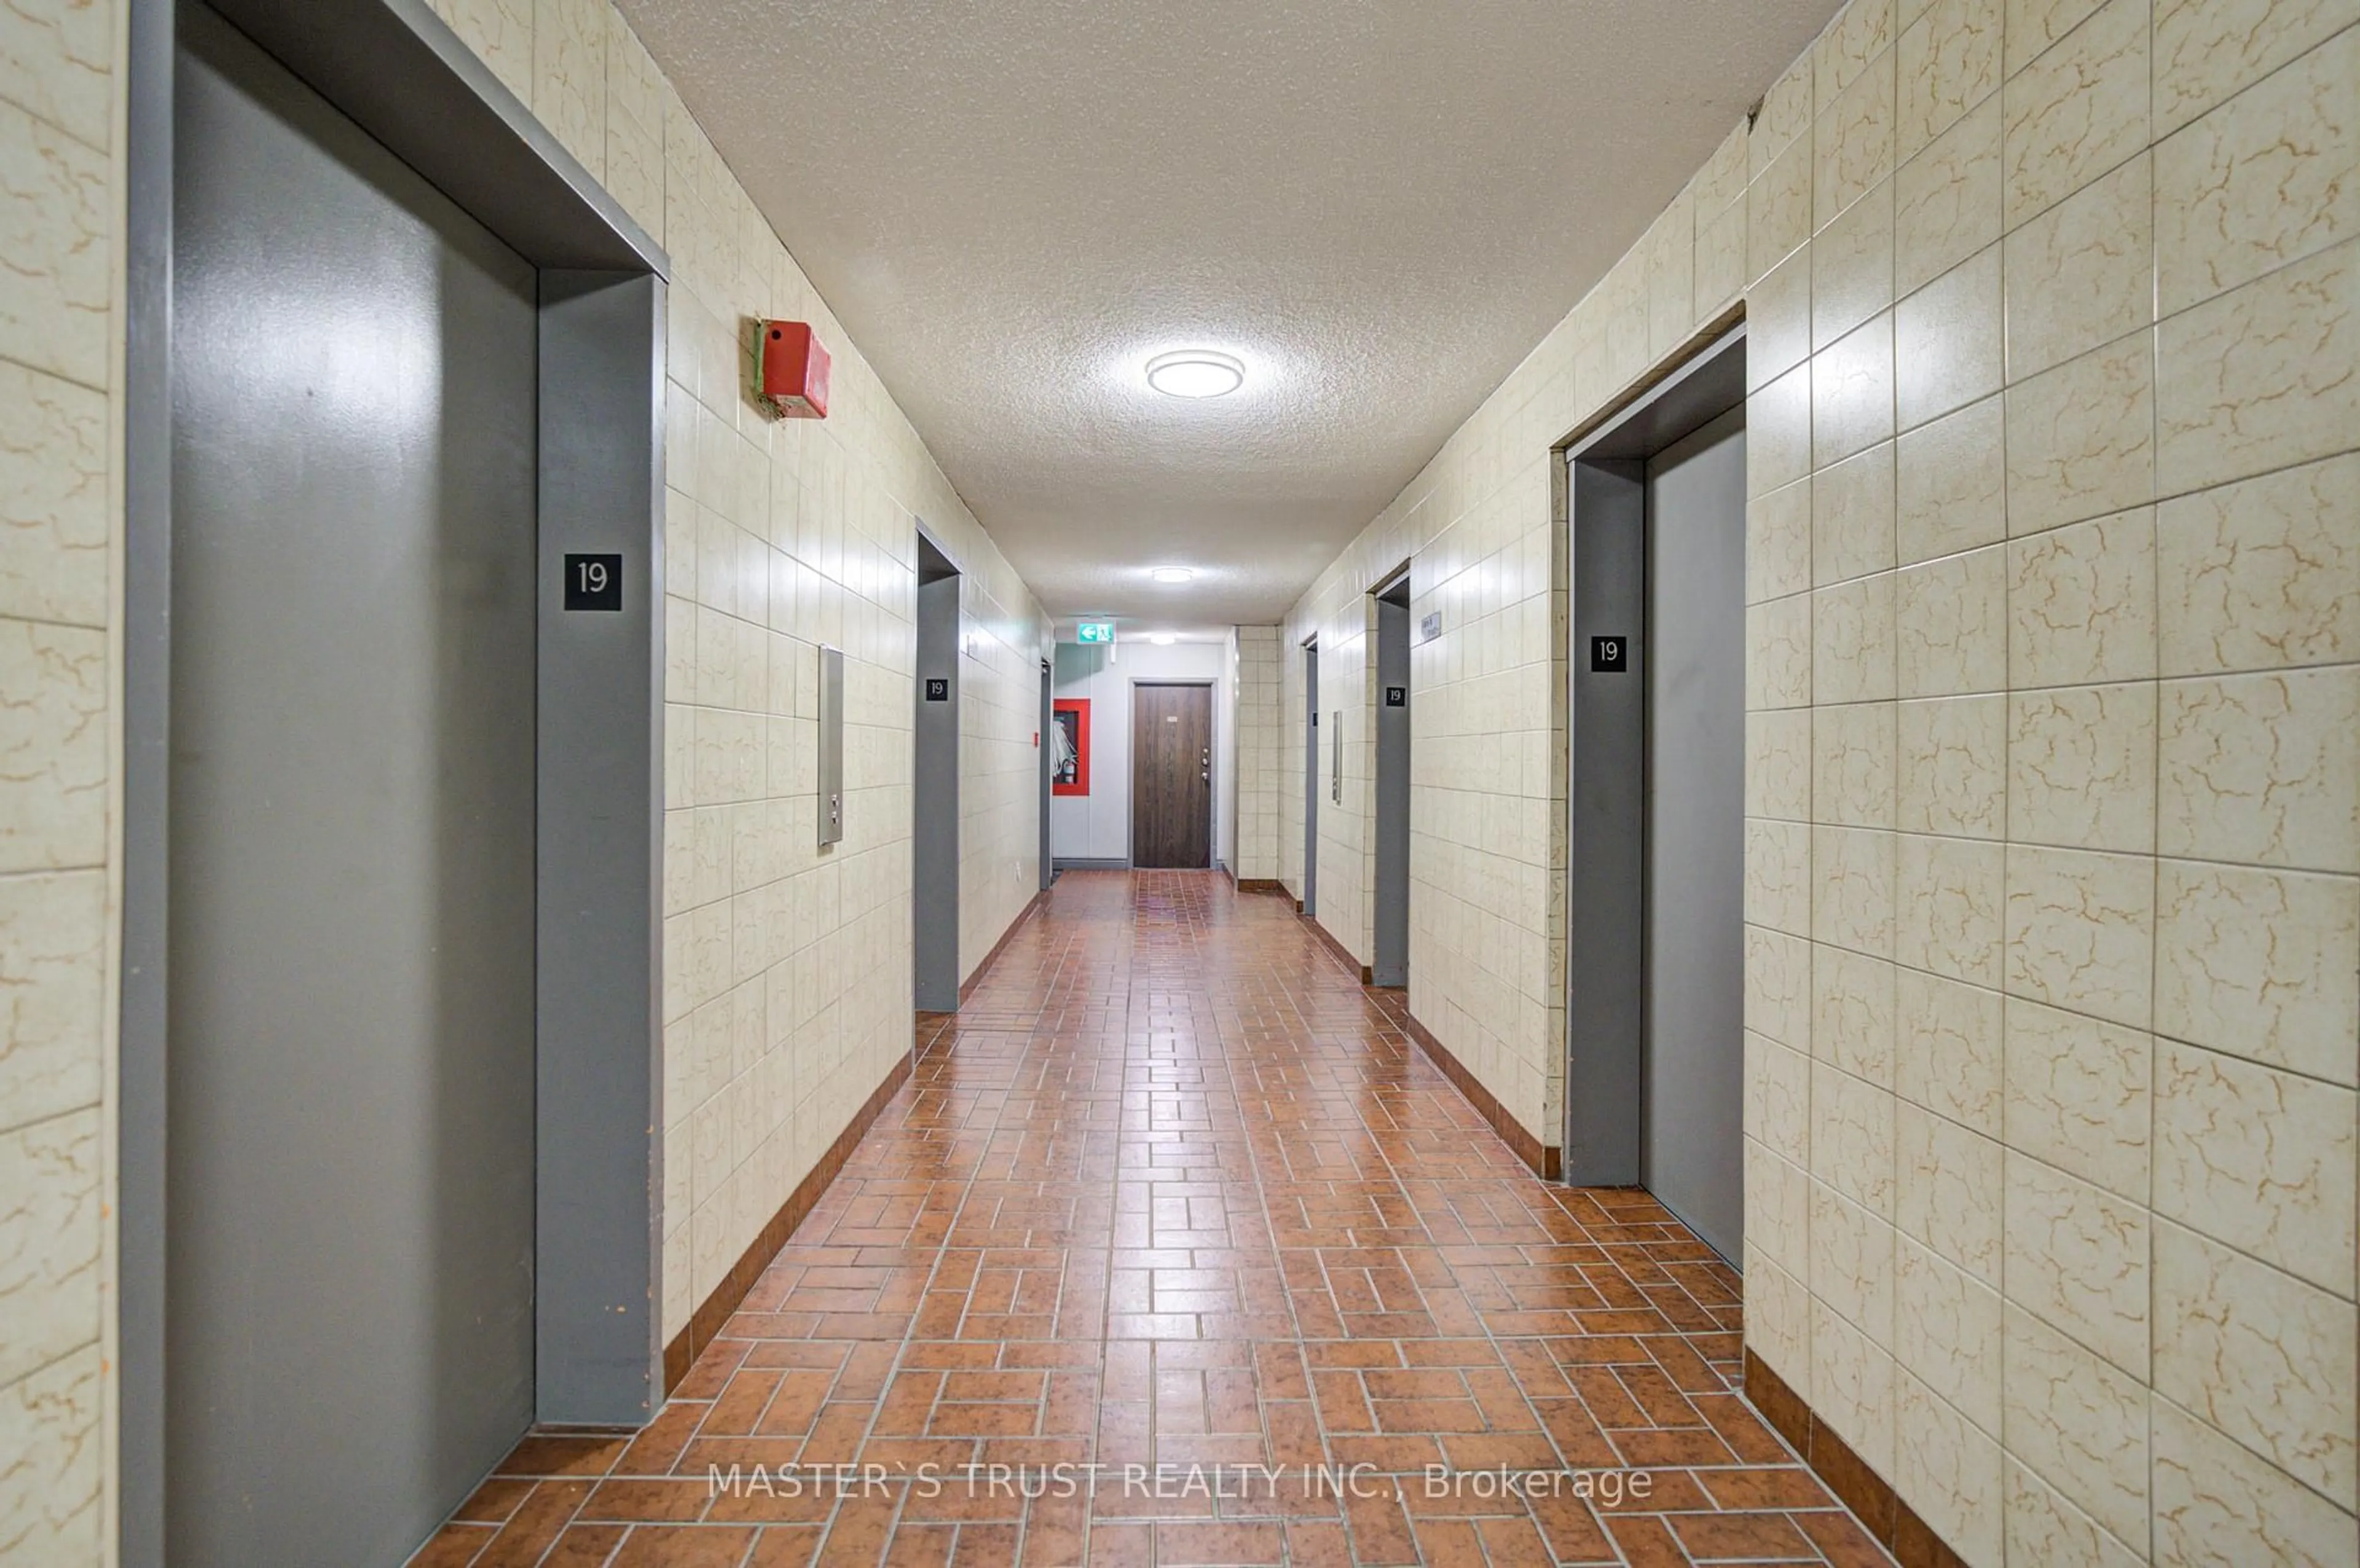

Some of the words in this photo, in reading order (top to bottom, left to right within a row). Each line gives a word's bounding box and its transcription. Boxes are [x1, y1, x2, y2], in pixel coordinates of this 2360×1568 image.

[578, 562, 608, 593] 19
[1600, 641, 1618, 661] 19
[932, 681, 943, 694] 19
[1391, 689, 1401, 700] 19
